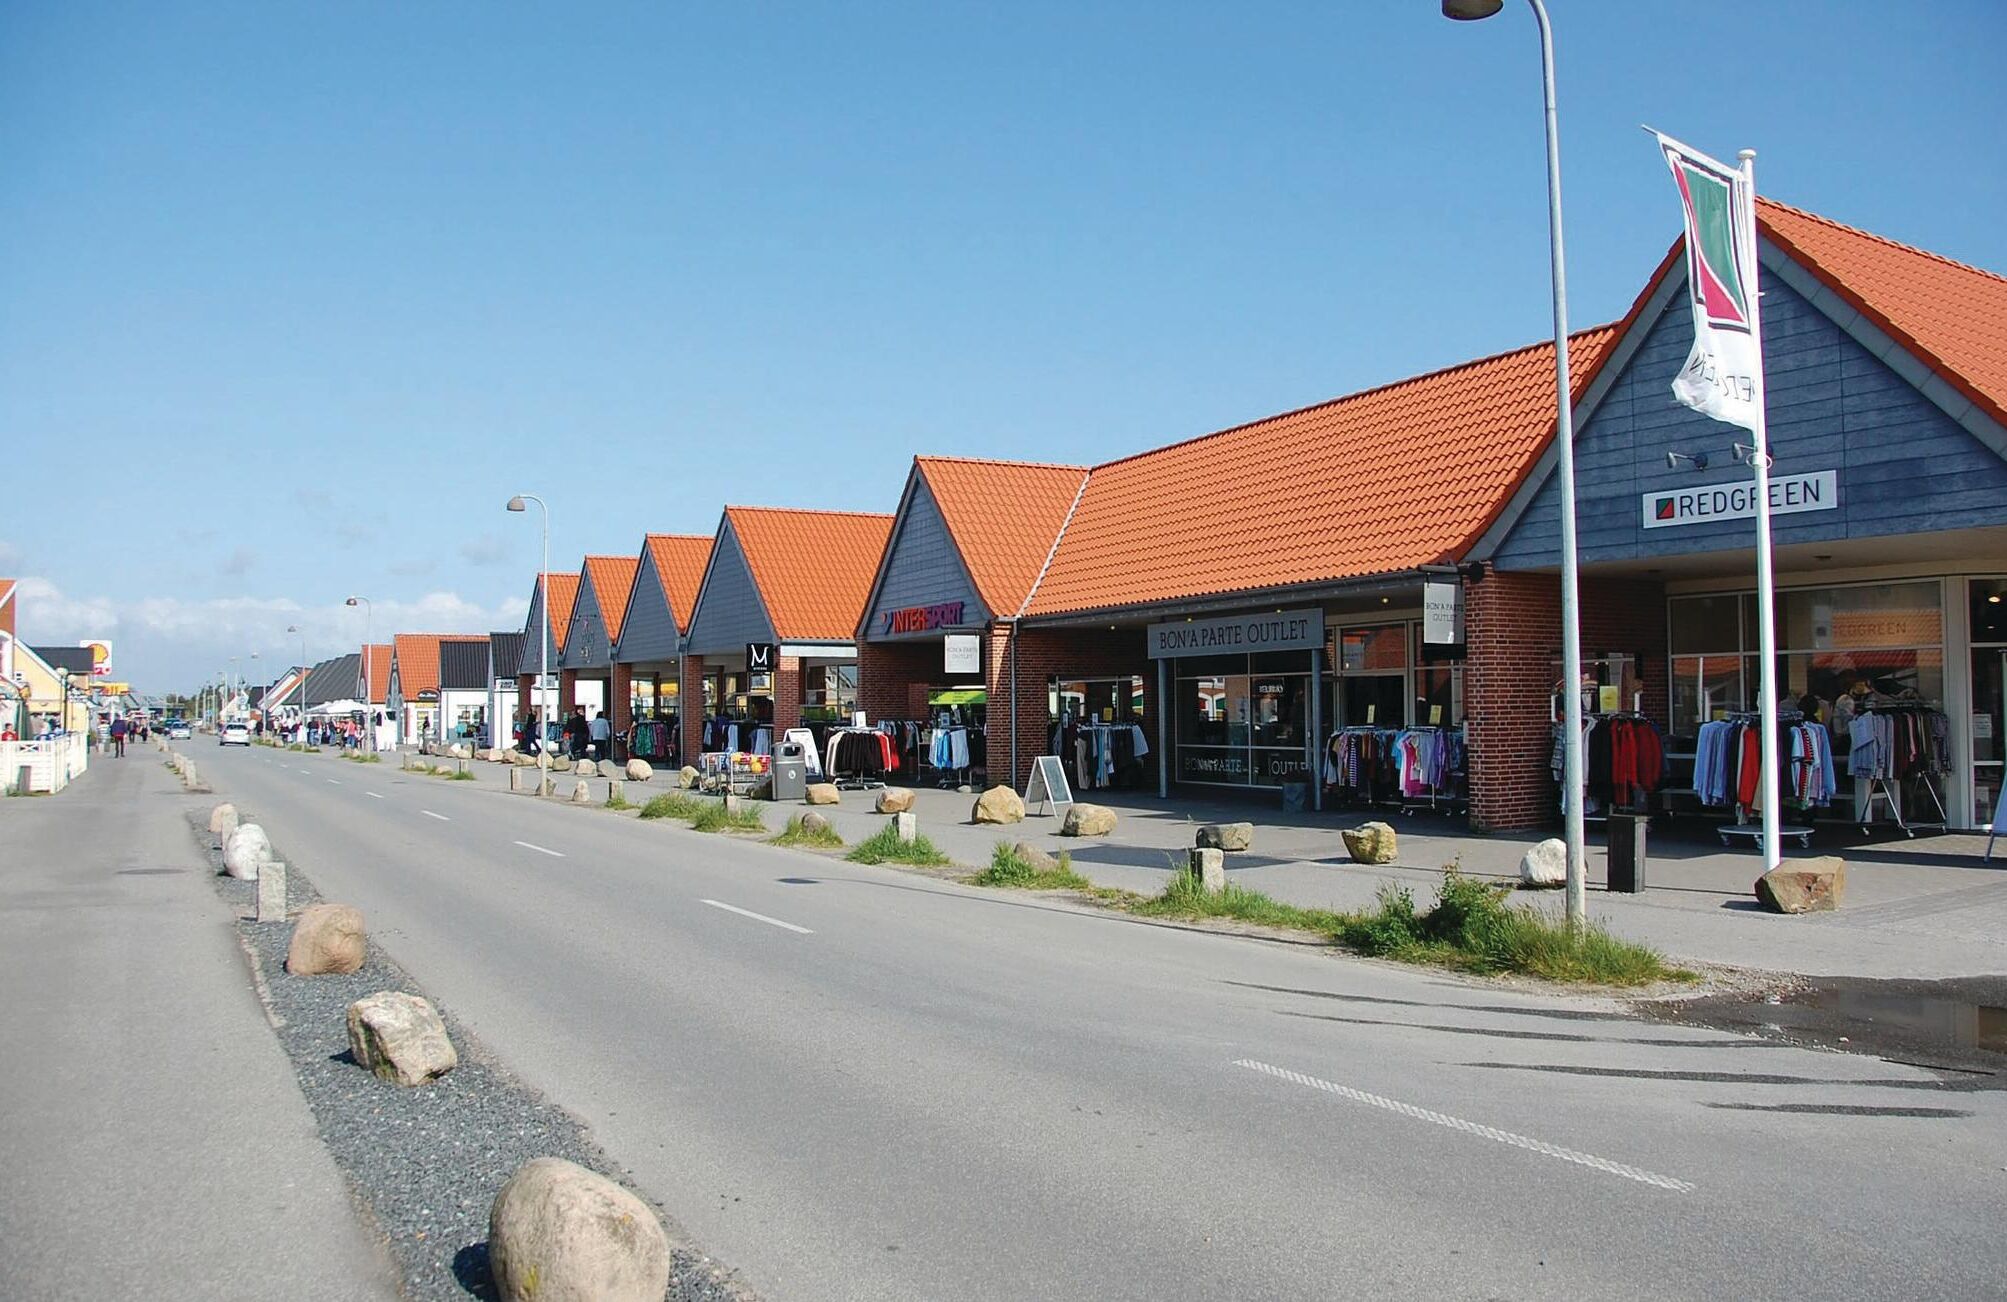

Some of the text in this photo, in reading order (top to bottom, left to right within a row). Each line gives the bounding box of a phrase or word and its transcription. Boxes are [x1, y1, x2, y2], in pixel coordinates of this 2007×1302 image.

[893, 601, 964, 634] INTERSPORT
[1202, 625, 1242, 647] PARTE
[1247, 619, 1308, 643] OUTLET
